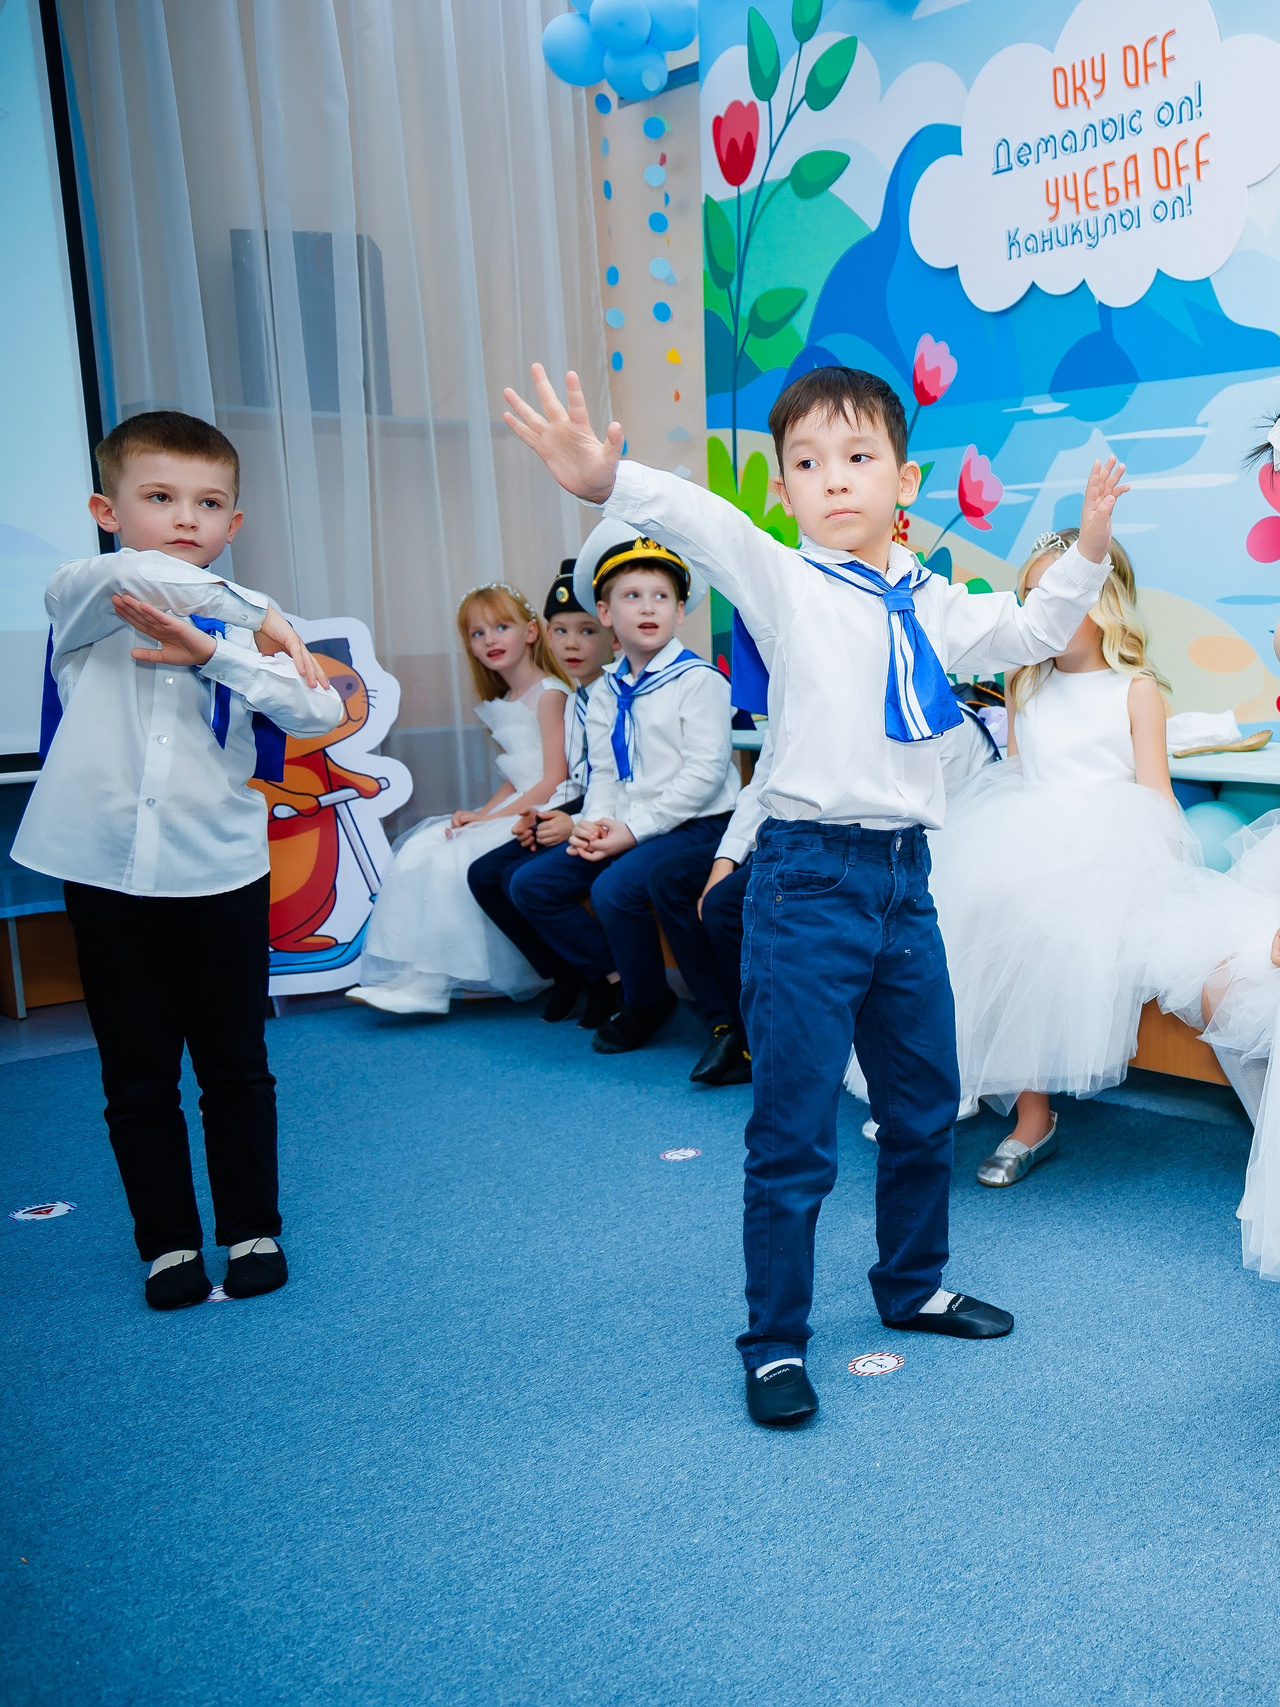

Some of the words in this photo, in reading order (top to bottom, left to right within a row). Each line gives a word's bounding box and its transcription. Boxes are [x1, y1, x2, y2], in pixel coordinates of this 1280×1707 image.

[1052, 52, 1106, 110] ОҚУ
[1122, 28, 1176, 89] OFF
[991, 108, 1143, 176] Демалыс
[1044, 152, 1141, 222] УЧЕБА
[1152, 132, 1211, 191] OFF
[1005, 205, 1142, 260] Каникулы
